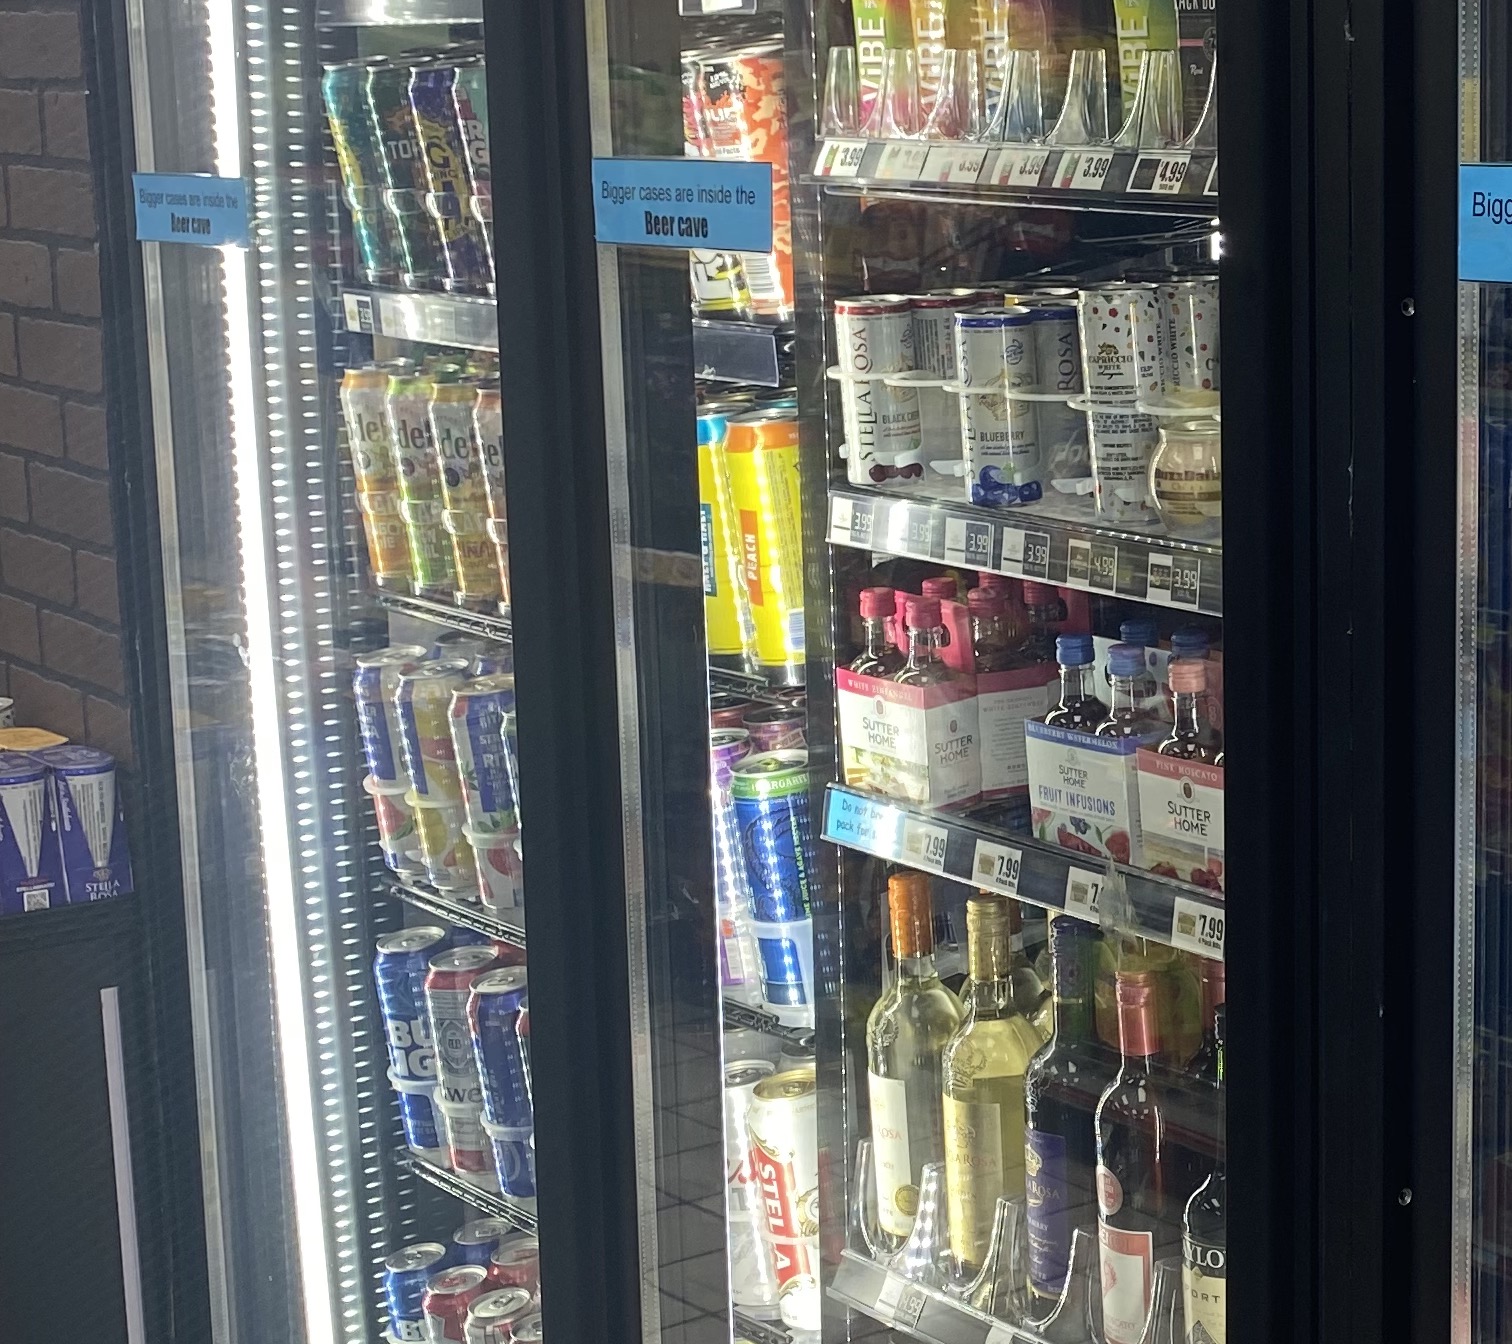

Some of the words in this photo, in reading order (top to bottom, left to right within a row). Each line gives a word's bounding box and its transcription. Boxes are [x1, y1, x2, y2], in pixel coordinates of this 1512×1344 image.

[602, 181, 636, 205] Bigger
[639, 187, 672, 203] cases
[675, 189, 694, 204] are
[697, 185, 732, 205] inside
[736, 187, 756, 205] the
[645, 211, 675, 237] Beer
[678, 217, 709, 239] cave
[746, 531, 759, 582] PEACH
[862, 715, 900, 738] SUTTER
[867, 731, 898, 749] HOME
[934, 733, 974, 755] SUTTER
[939, 746, 971, 765] HOME
[1058, 763, 1089, 780] SUTTER
[1062, 775, 1087, 790] HOME
[1038, 784, 1064, 803] FRUIT
[1065, 789, 1117, 818] INFUSIONS
[1166, 799, 1212, 824] SUTTER
[1173, 817, 1209, 837] HOME
